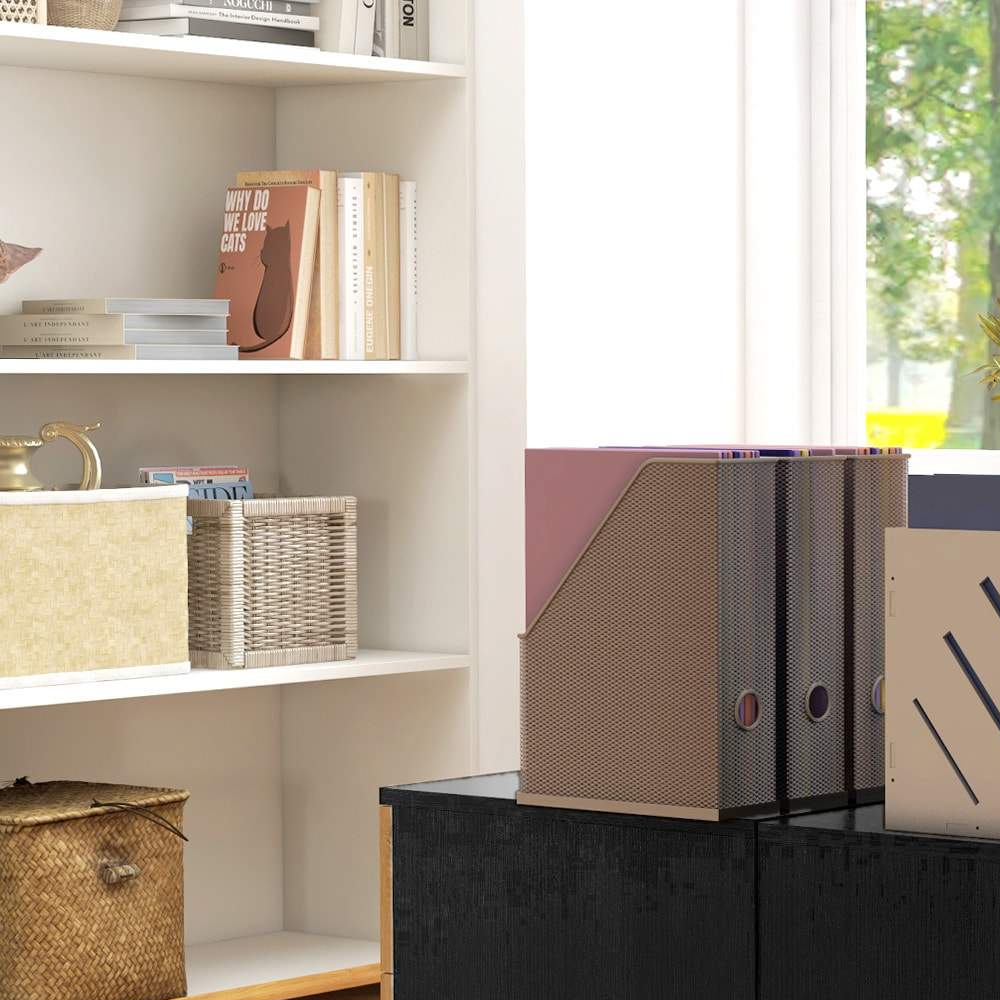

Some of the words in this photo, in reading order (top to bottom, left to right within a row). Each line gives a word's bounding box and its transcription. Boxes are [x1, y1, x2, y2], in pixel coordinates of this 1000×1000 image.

[223, 0, 272, 11] NOGUCHI
[225, 190, 252, 212] WHY
[253, 189, 270, 211] DO
[223, 212, 241, 232] WE
[241, 211, 268, 232] LOVE
[220, 233, 247, 253] CATS
[365, 265, 374, 307] ONEGIN
[365, 309, 374, 353] EUGENE
